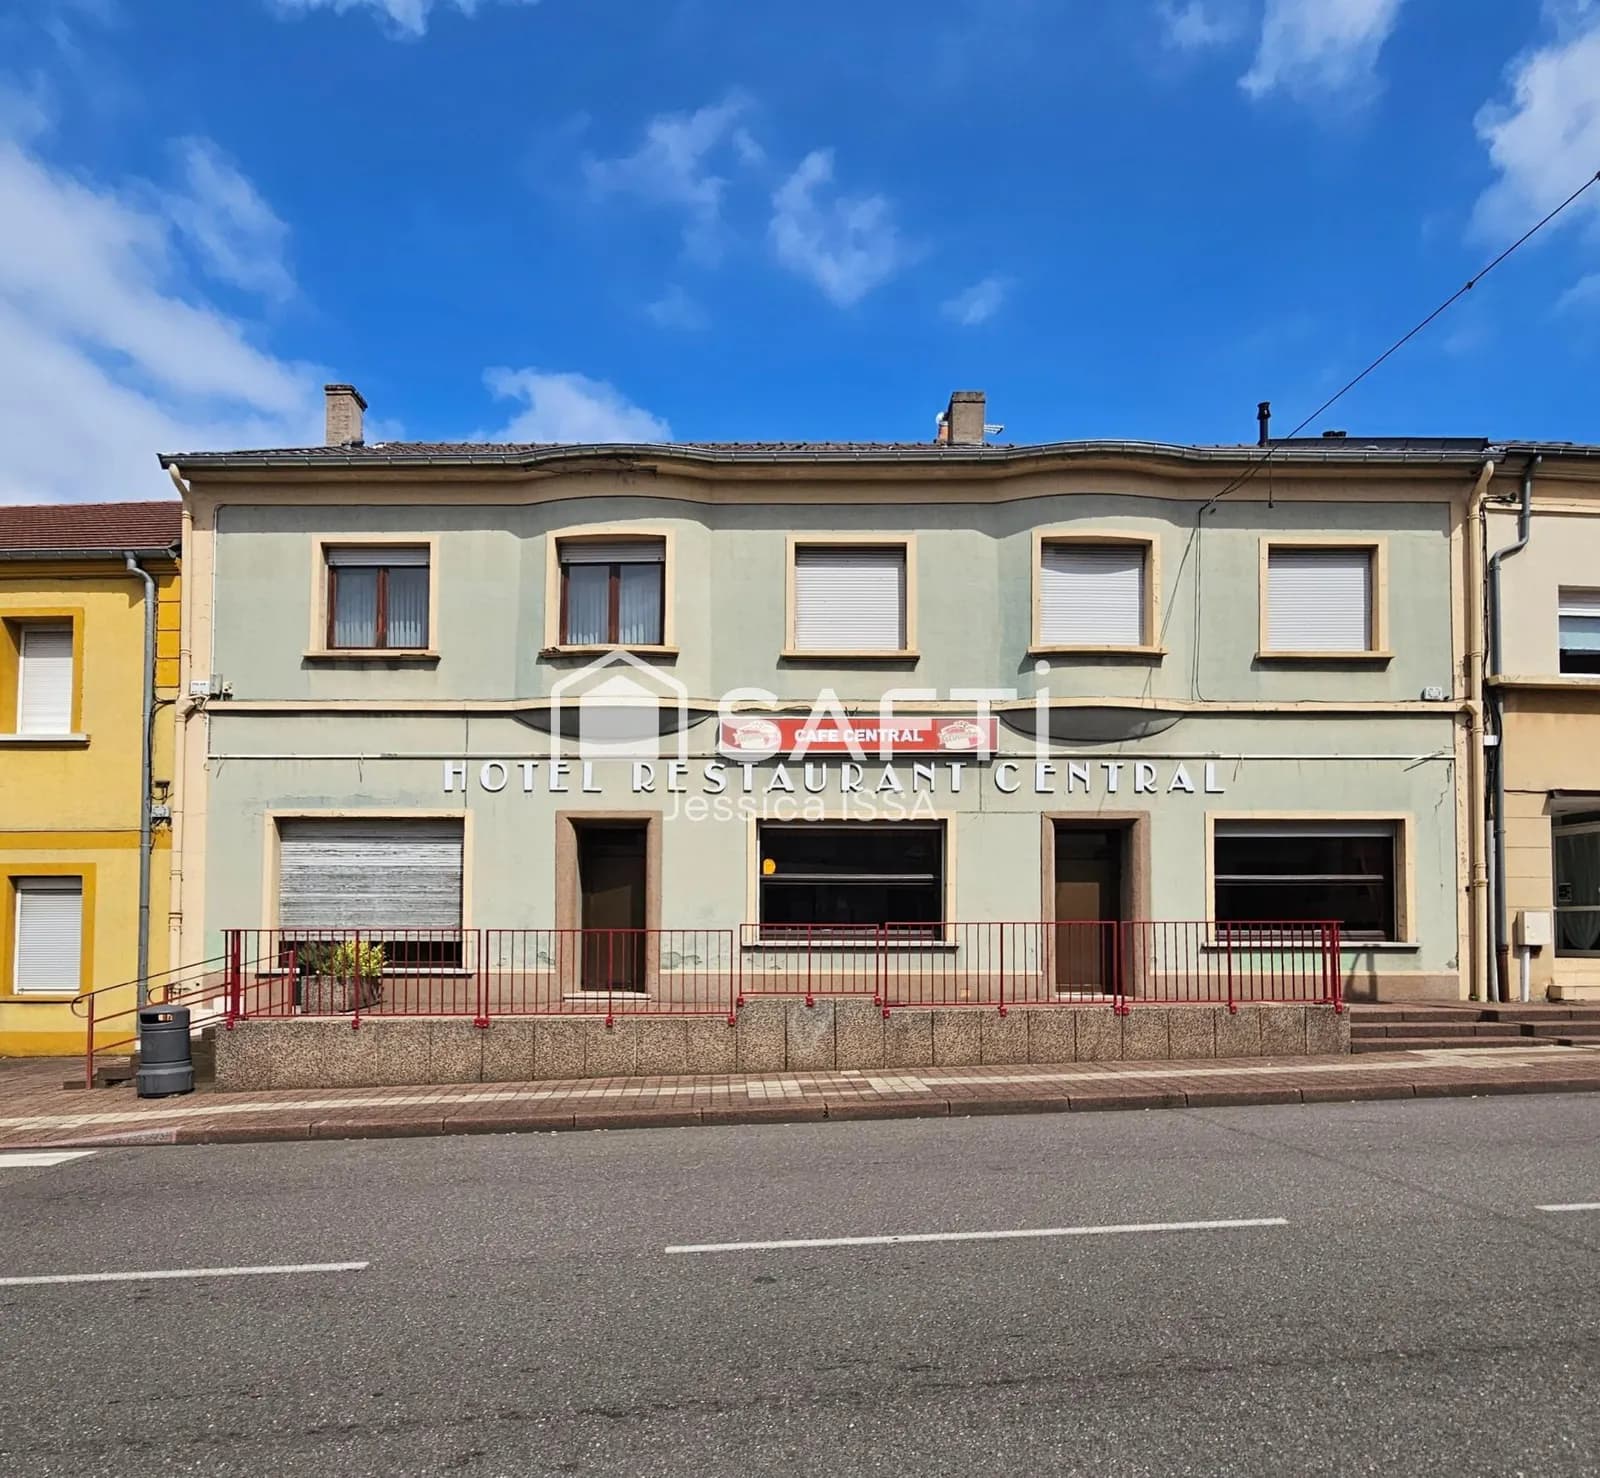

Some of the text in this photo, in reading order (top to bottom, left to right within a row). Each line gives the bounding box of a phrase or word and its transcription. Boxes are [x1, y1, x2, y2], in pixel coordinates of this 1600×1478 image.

[794, 728, 839, 743] CAFE
[843, 728, 923, 743] CENTRAL
[443, 760, 1227, 794] HOTEL RESTAURANT CENTRAL
